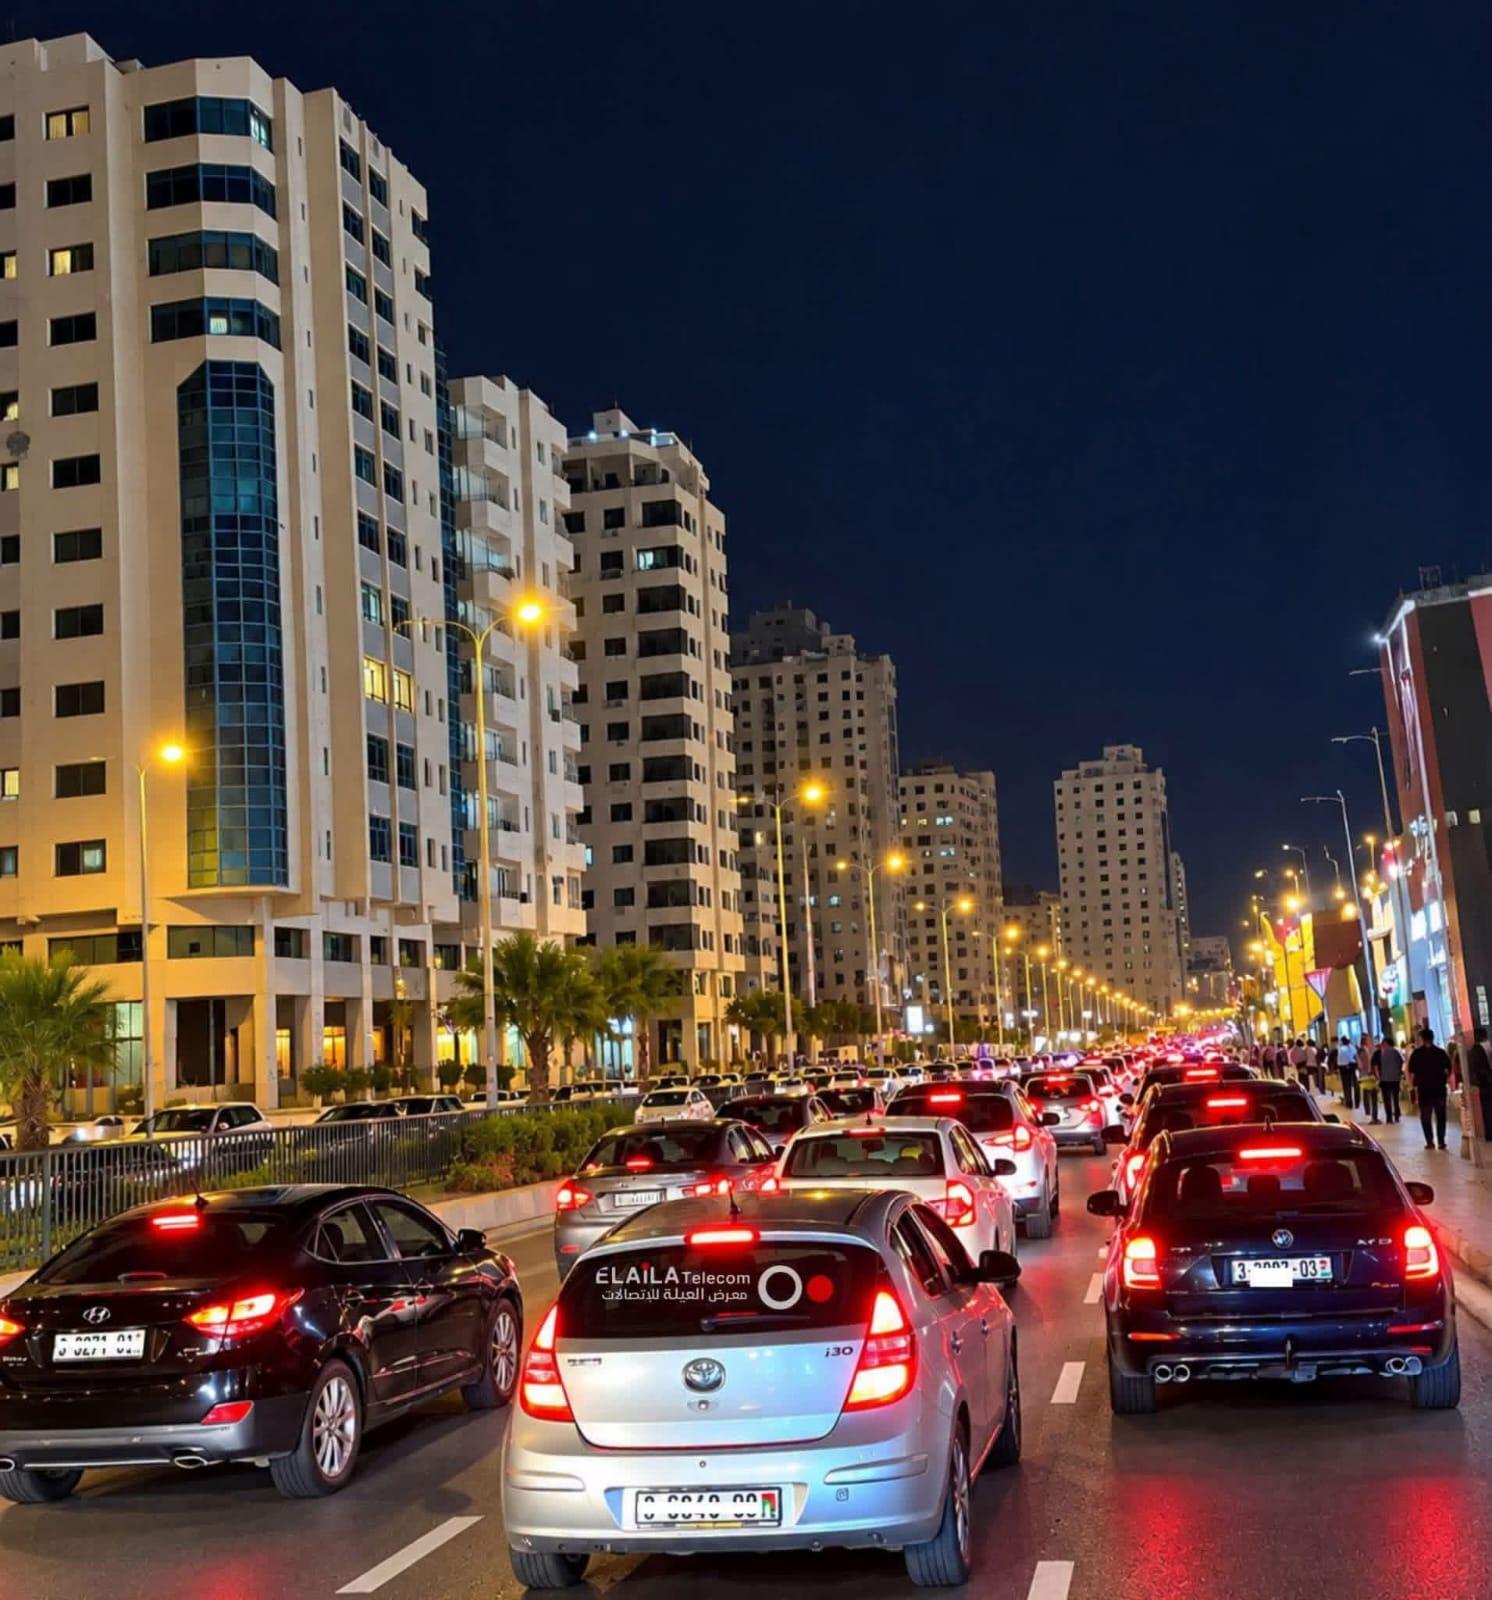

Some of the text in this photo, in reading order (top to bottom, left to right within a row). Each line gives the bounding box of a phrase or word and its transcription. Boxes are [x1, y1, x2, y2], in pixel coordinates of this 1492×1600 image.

[681, 1271, 751, 1285] Telecom
[662, 1287, 705, 1303] العيلة
[708, 1288, 748, 1303] معرض
[825, 1346, 854, 1357] i30
